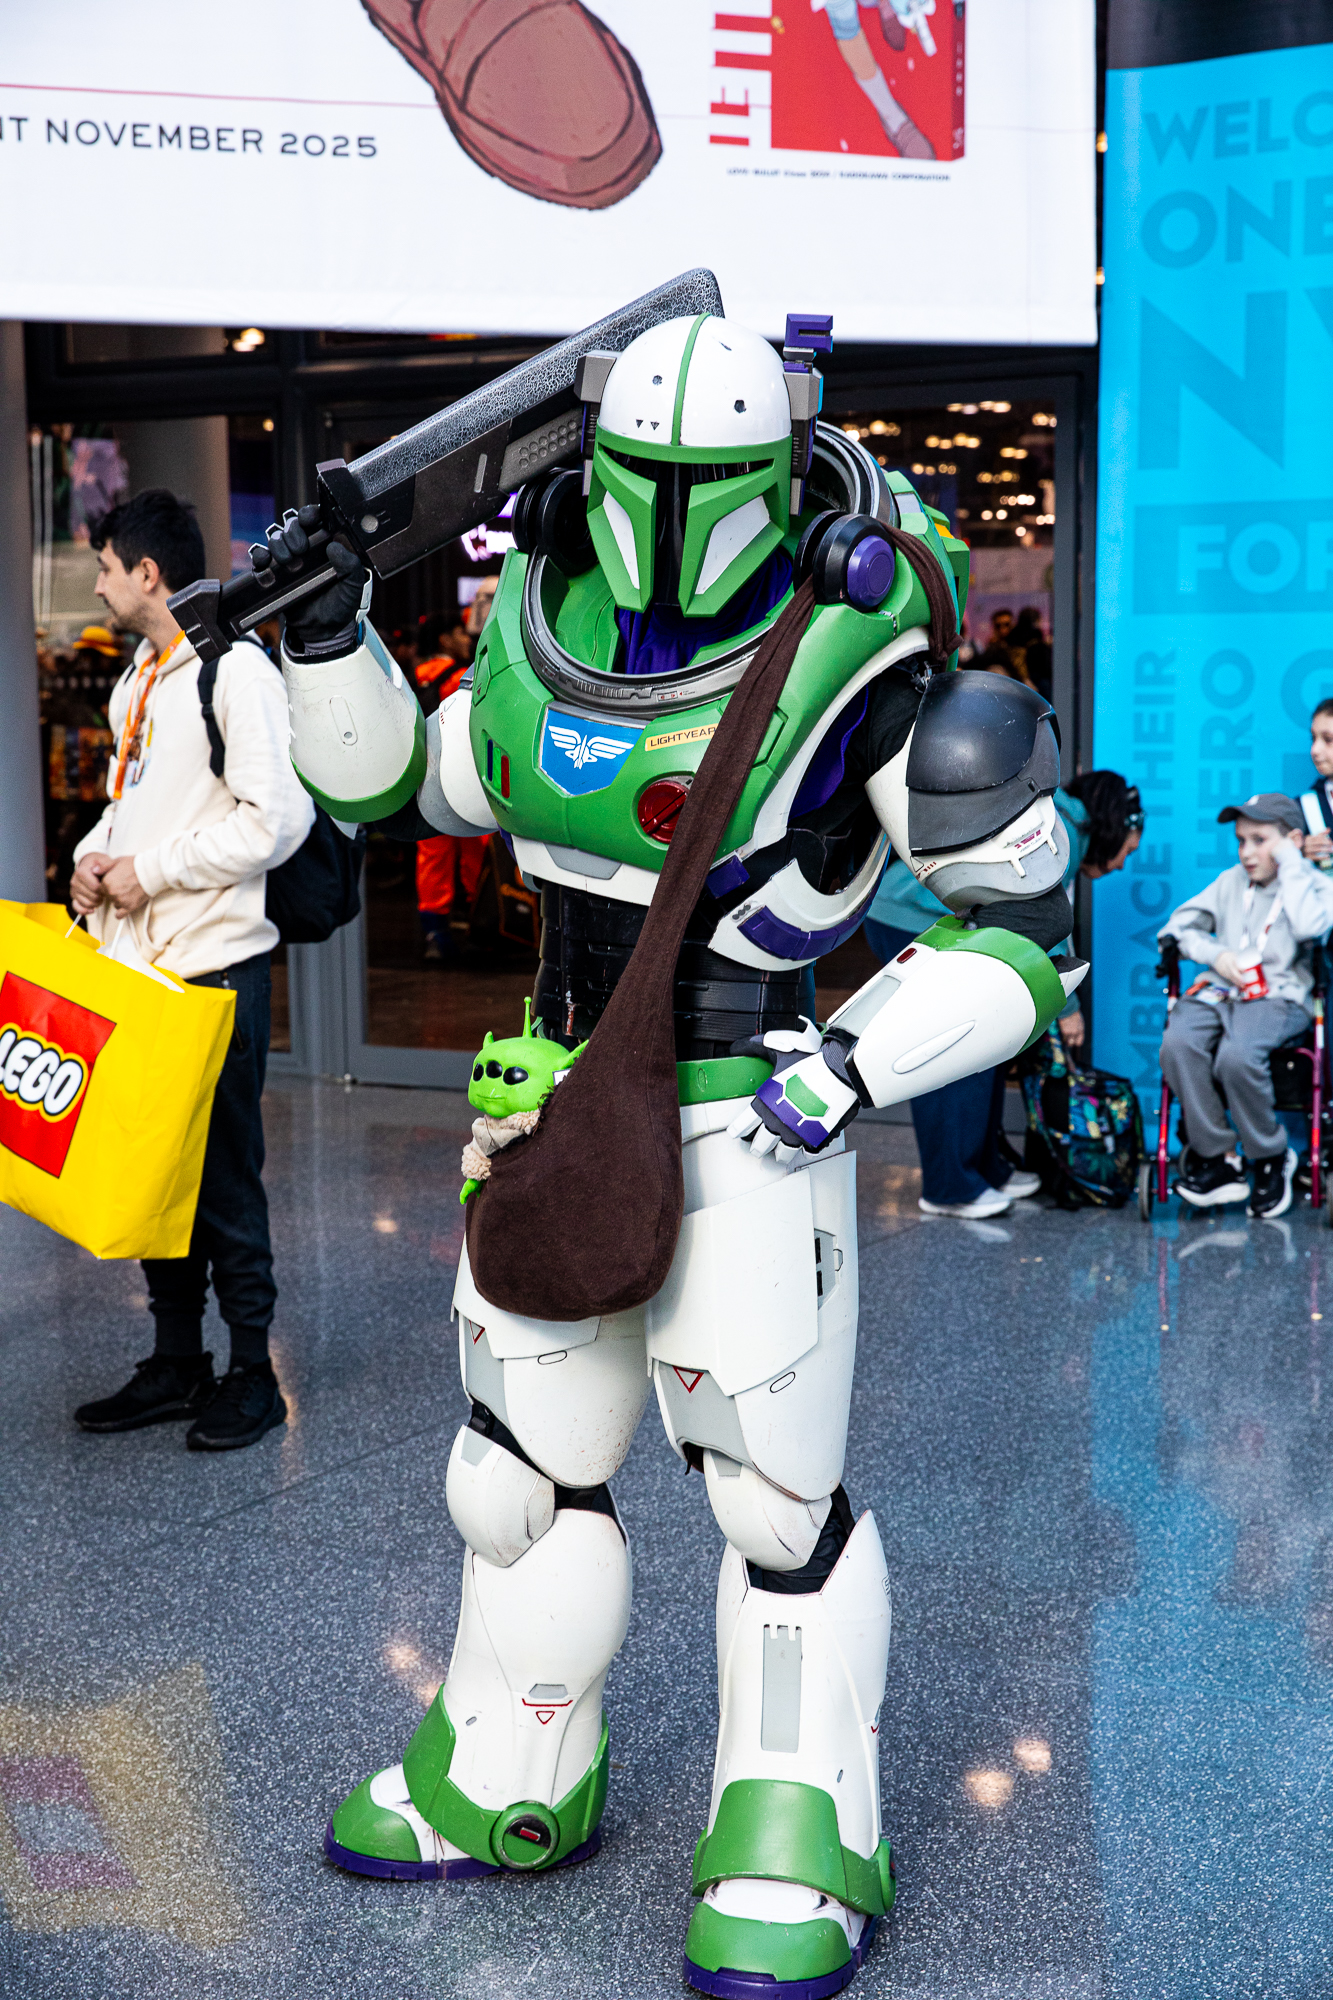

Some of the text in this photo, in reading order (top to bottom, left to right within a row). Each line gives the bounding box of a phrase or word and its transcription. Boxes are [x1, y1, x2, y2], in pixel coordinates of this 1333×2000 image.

[0, 116, 378, 158] T NOVEMBER 2025
[1197, 648, 1255, 868] HERO
